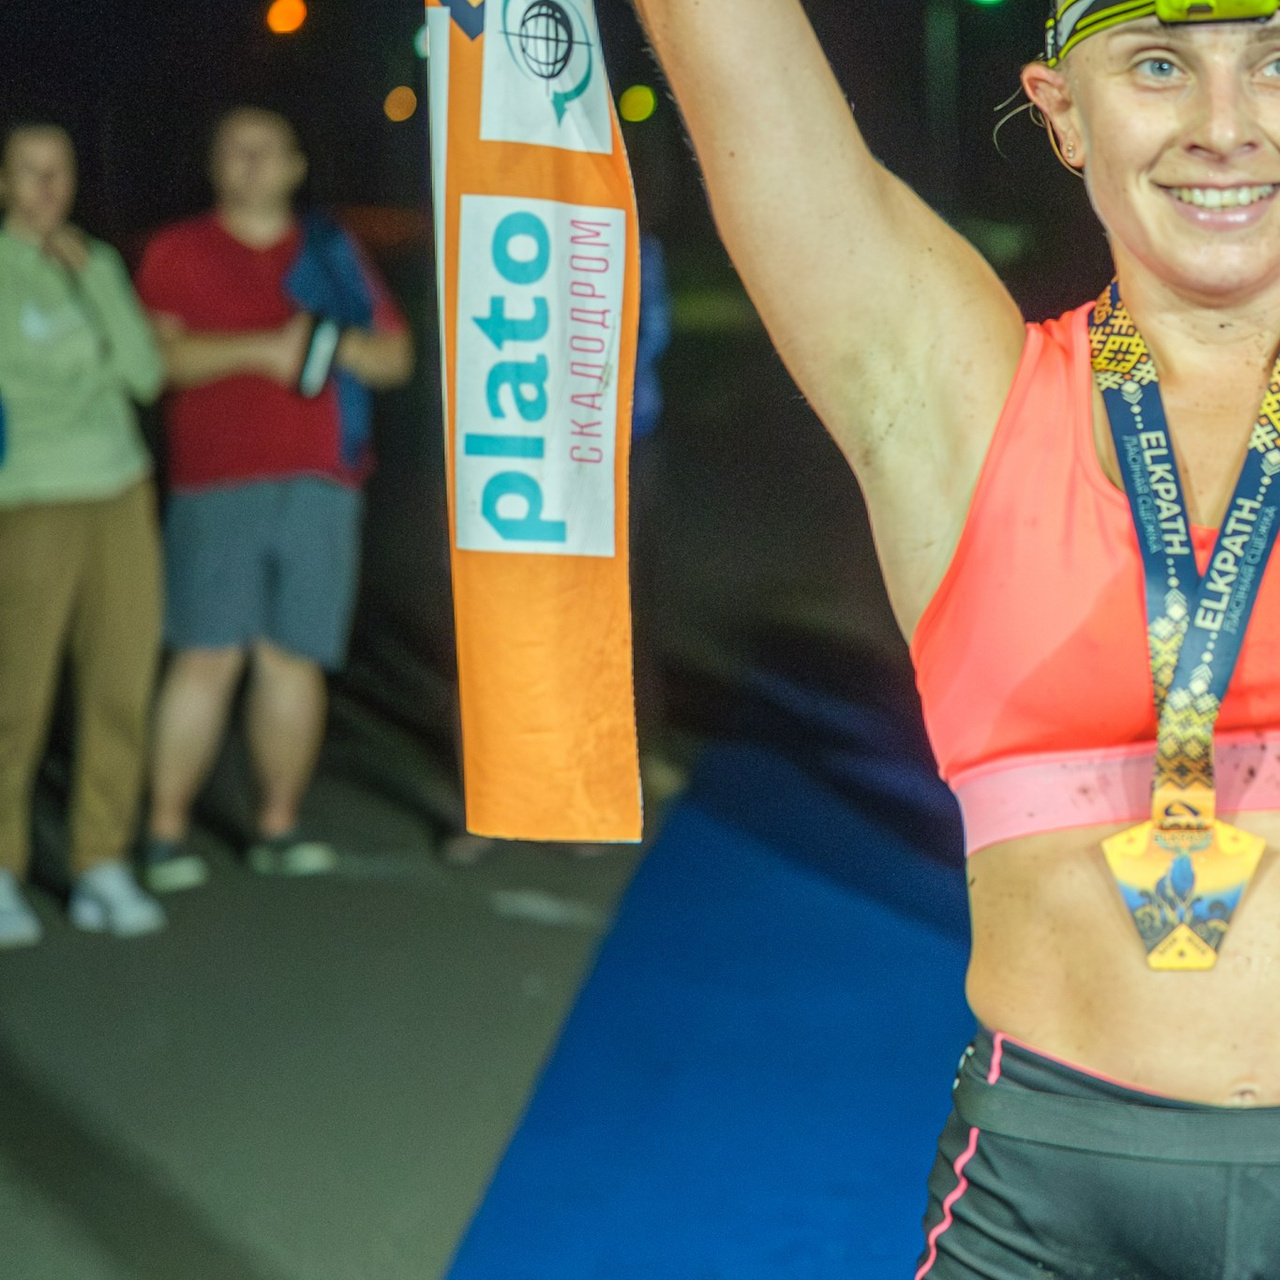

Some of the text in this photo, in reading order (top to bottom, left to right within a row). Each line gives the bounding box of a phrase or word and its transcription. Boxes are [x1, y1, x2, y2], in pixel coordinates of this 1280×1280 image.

[464, 210, 568, 543] plato
[569, 219, 612, 465] СКАЛОДРОМ
[1139, 430, 1191, 555] ELKPATH
[1194, 497, 1262, 632] ELKPATH
